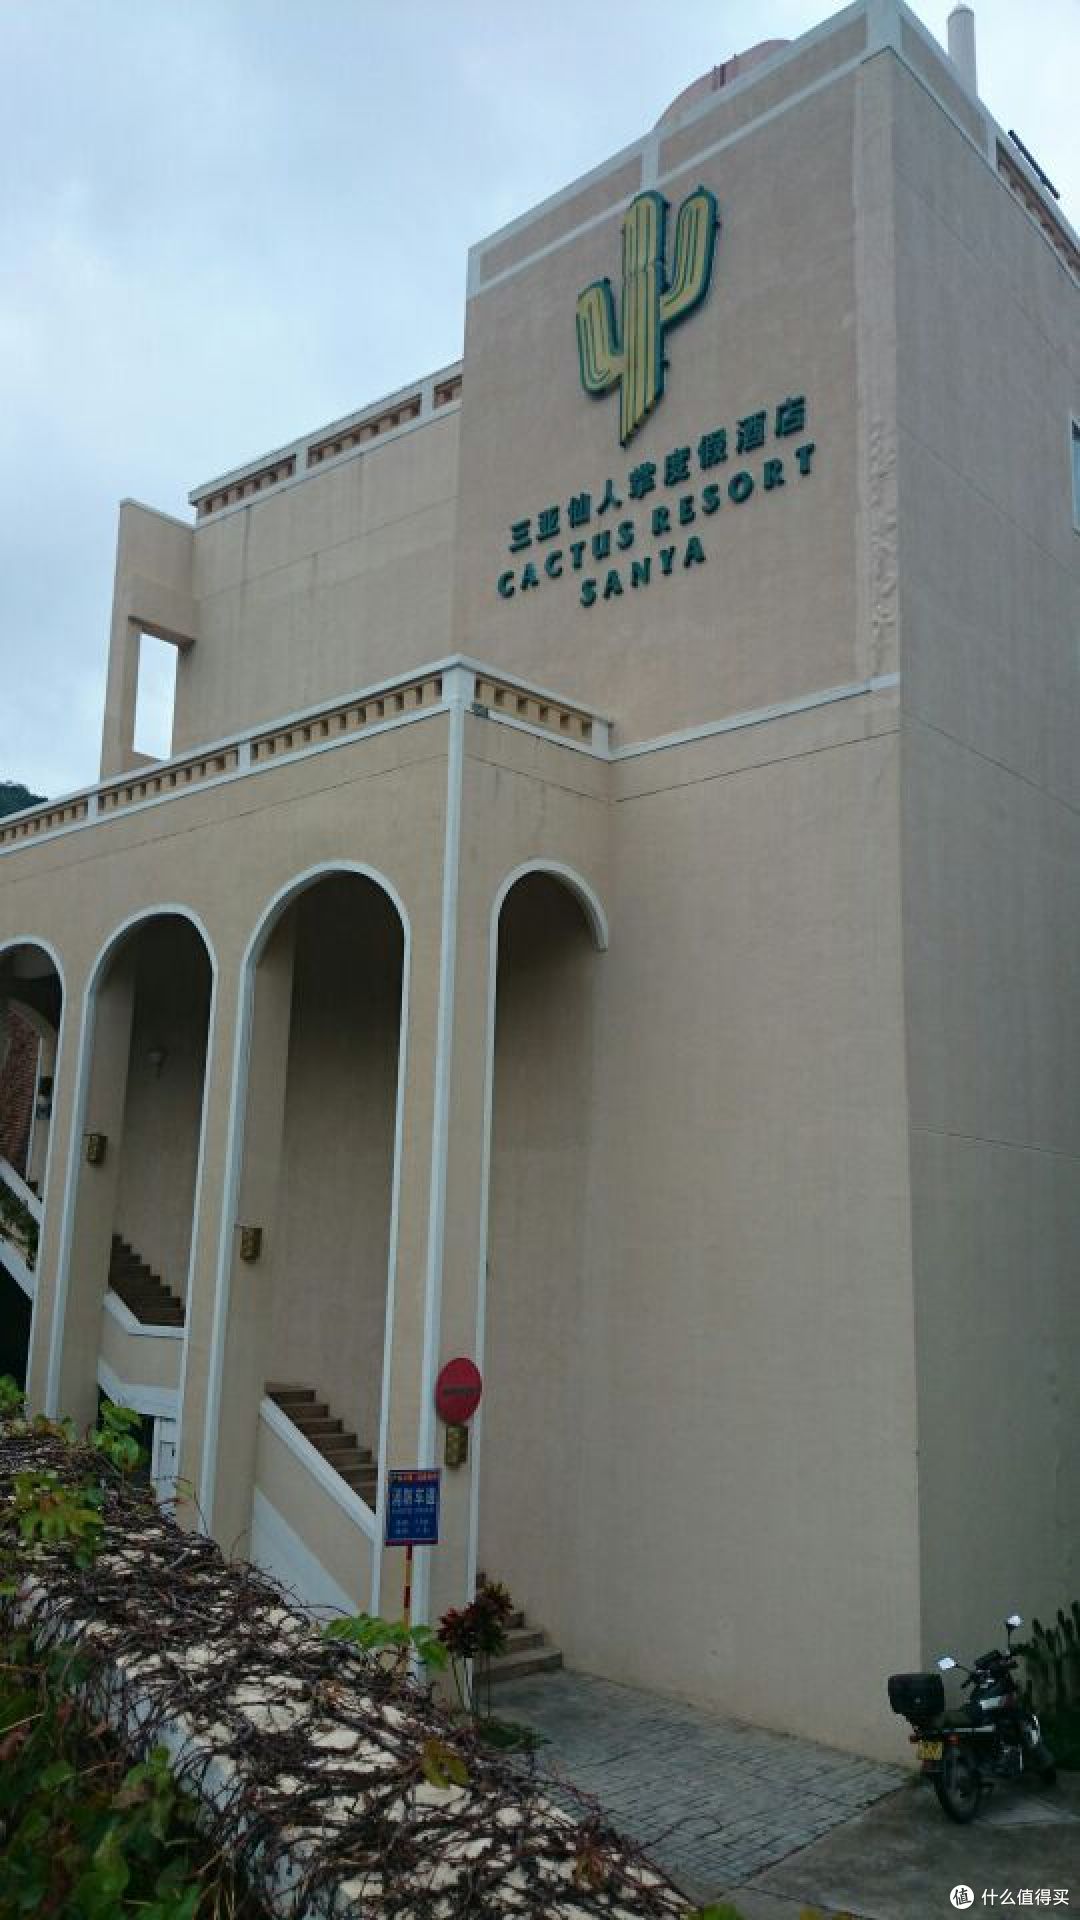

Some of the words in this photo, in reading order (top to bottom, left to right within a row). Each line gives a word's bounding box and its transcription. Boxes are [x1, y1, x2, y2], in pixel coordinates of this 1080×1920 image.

[497, 520, 635, 598] CACTUS
[651, 442, 816, 536] RESORT
[509, 395, 806, 552] 三亚仙人掌度假酒店
[579, 535, 706, 608] SANYA
